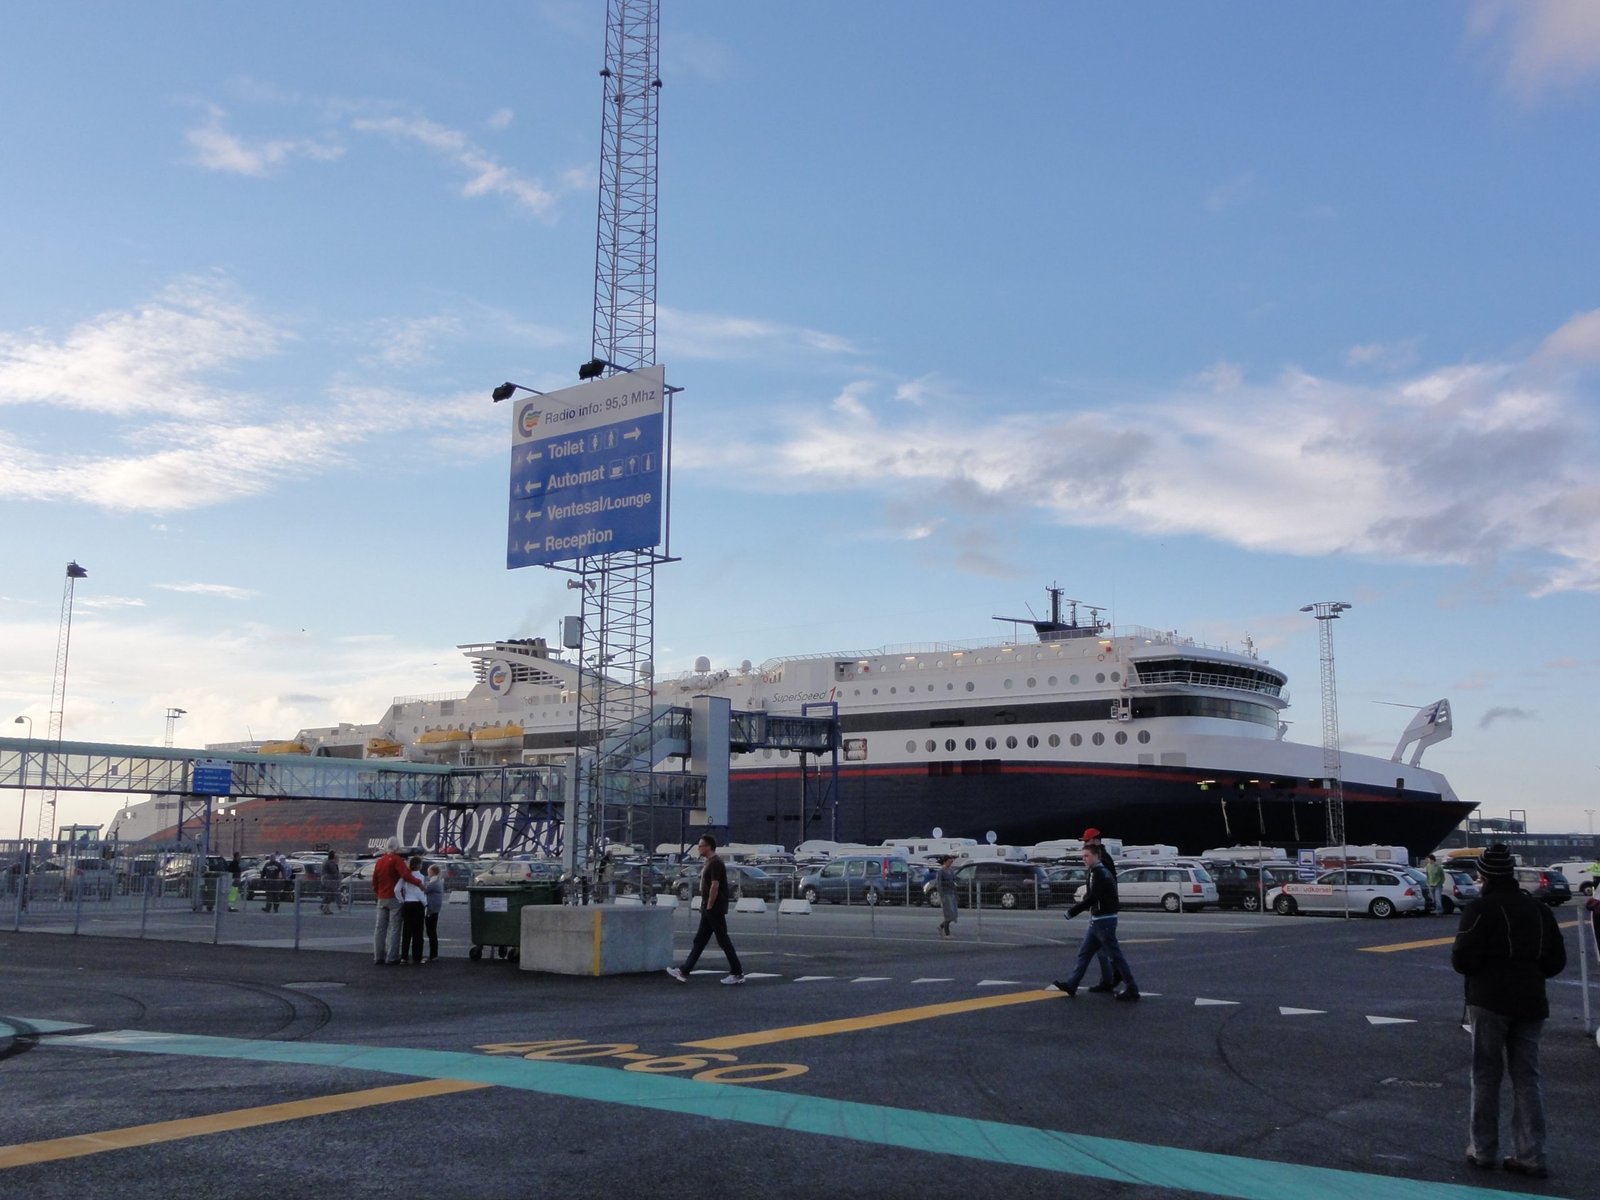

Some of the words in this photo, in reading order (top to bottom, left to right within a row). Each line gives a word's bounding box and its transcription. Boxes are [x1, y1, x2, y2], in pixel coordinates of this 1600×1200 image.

[545, 409, 576, 424] Radio
[579, 402, 602, 416] info:
[605, 394, 628, 410] 95,3
[631, 390, 655, 404] Mhz
[548, 438, 584, 459] Toilet
[547, 465, 605, 490] Automat
[547, 492, 651, 520] Ventesal/Lounge
[545, 528, 613, 551] Reception
[772, 690, 827, 703] SuperSpeed
[473, 1039, 810, 1083] 40-60
